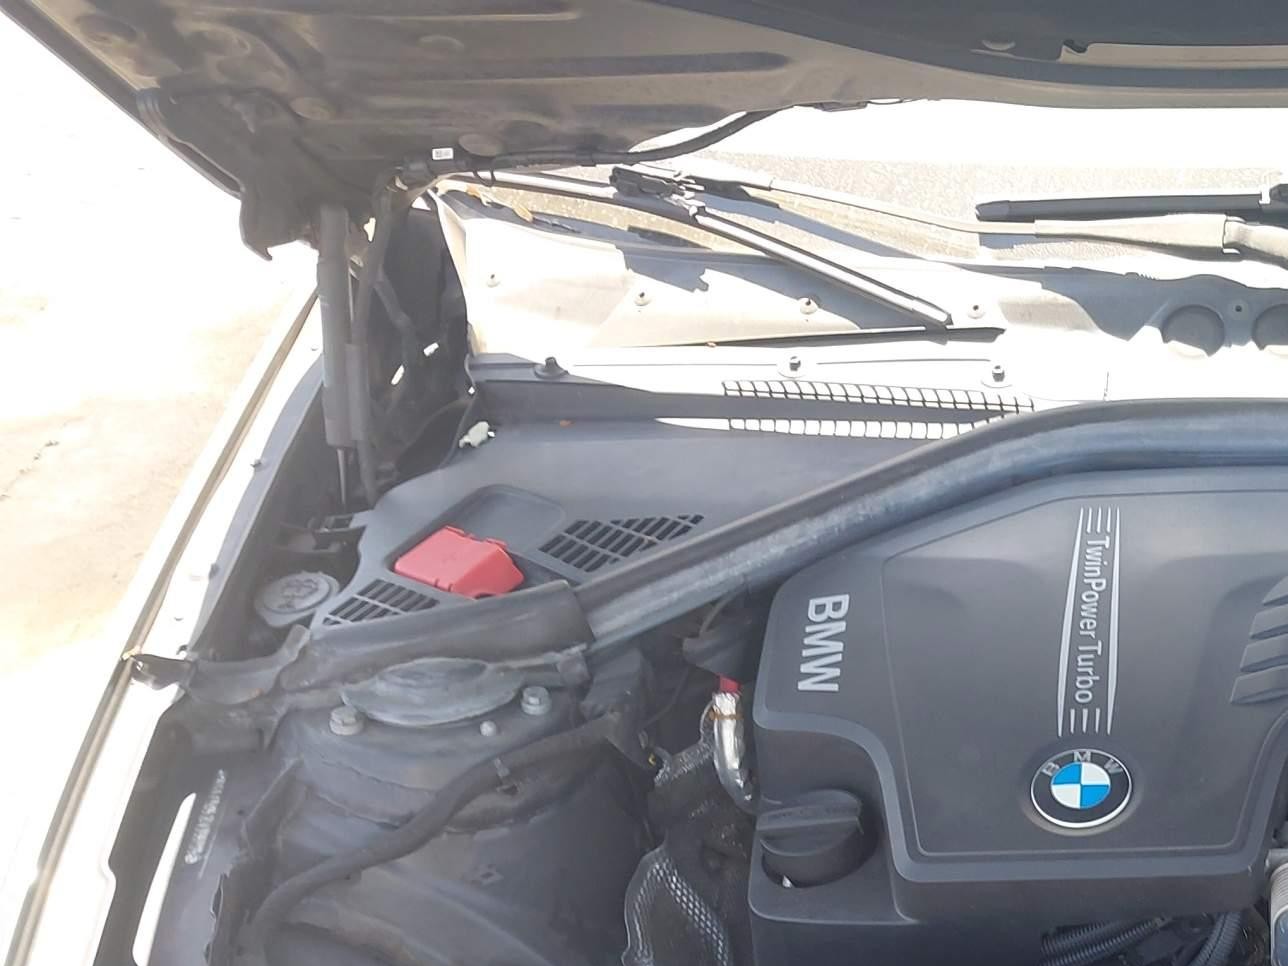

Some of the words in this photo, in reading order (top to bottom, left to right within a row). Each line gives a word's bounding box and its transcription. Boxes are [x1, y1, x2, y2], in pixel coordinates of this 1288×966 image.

[1079, 535, 1110, 638] TwinPower
[797, 593, 850, 692] BMW
[1075, 640, 1102, 704] Turbo
[1041, 750, 1123, 778] BMW
